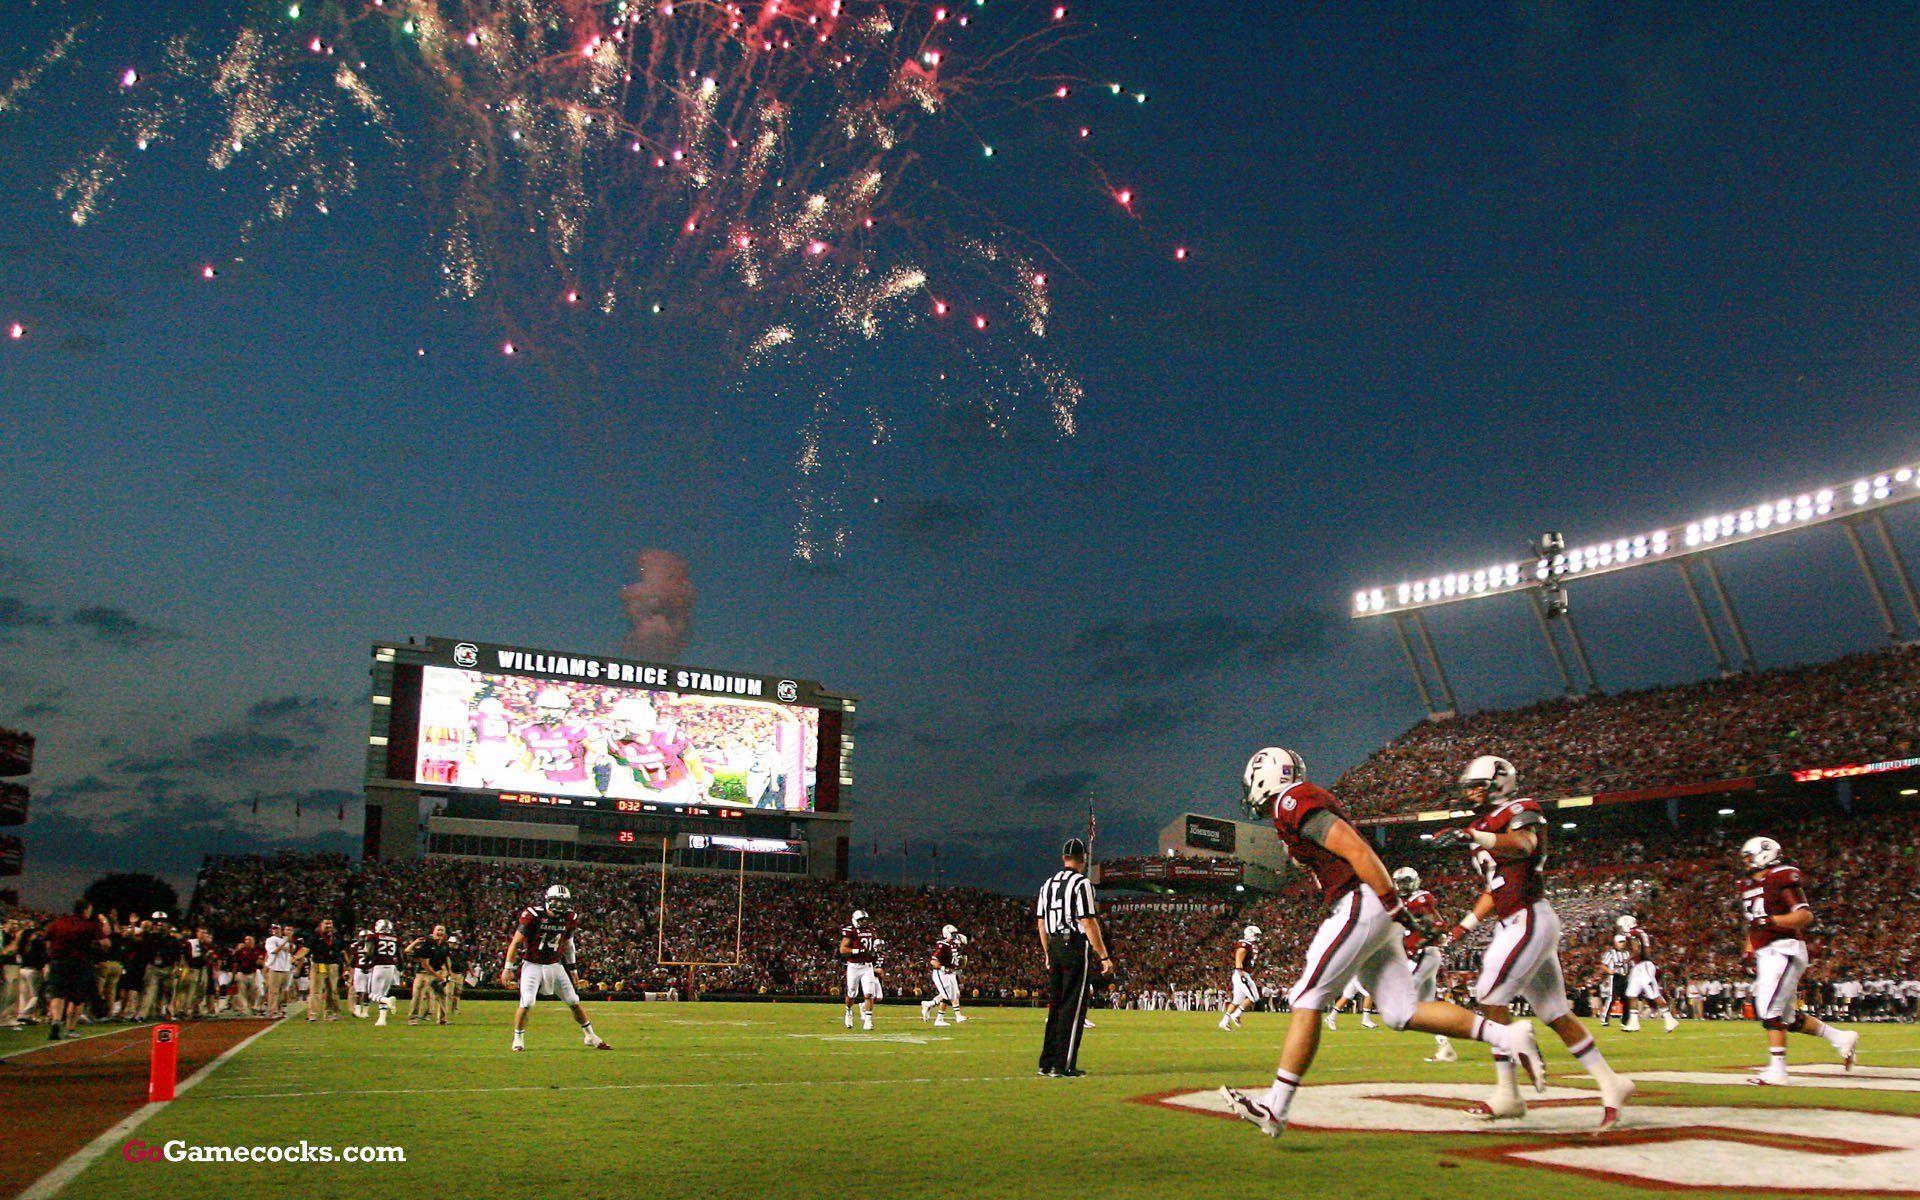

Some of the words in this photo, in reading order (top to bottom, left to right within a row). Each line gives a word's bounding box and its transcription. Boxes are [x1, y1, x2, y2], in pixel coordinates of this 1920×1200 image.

[498, 650, 668, 686] WILLIAMS-BRICE
[676, 670, 763, 696] STADIUM
[618, 800, 640, 812] 0:32
[620, 832, 633, 842] 25
[377, 940, 396, 956] 23
[538, 932, 562, 952] 14
